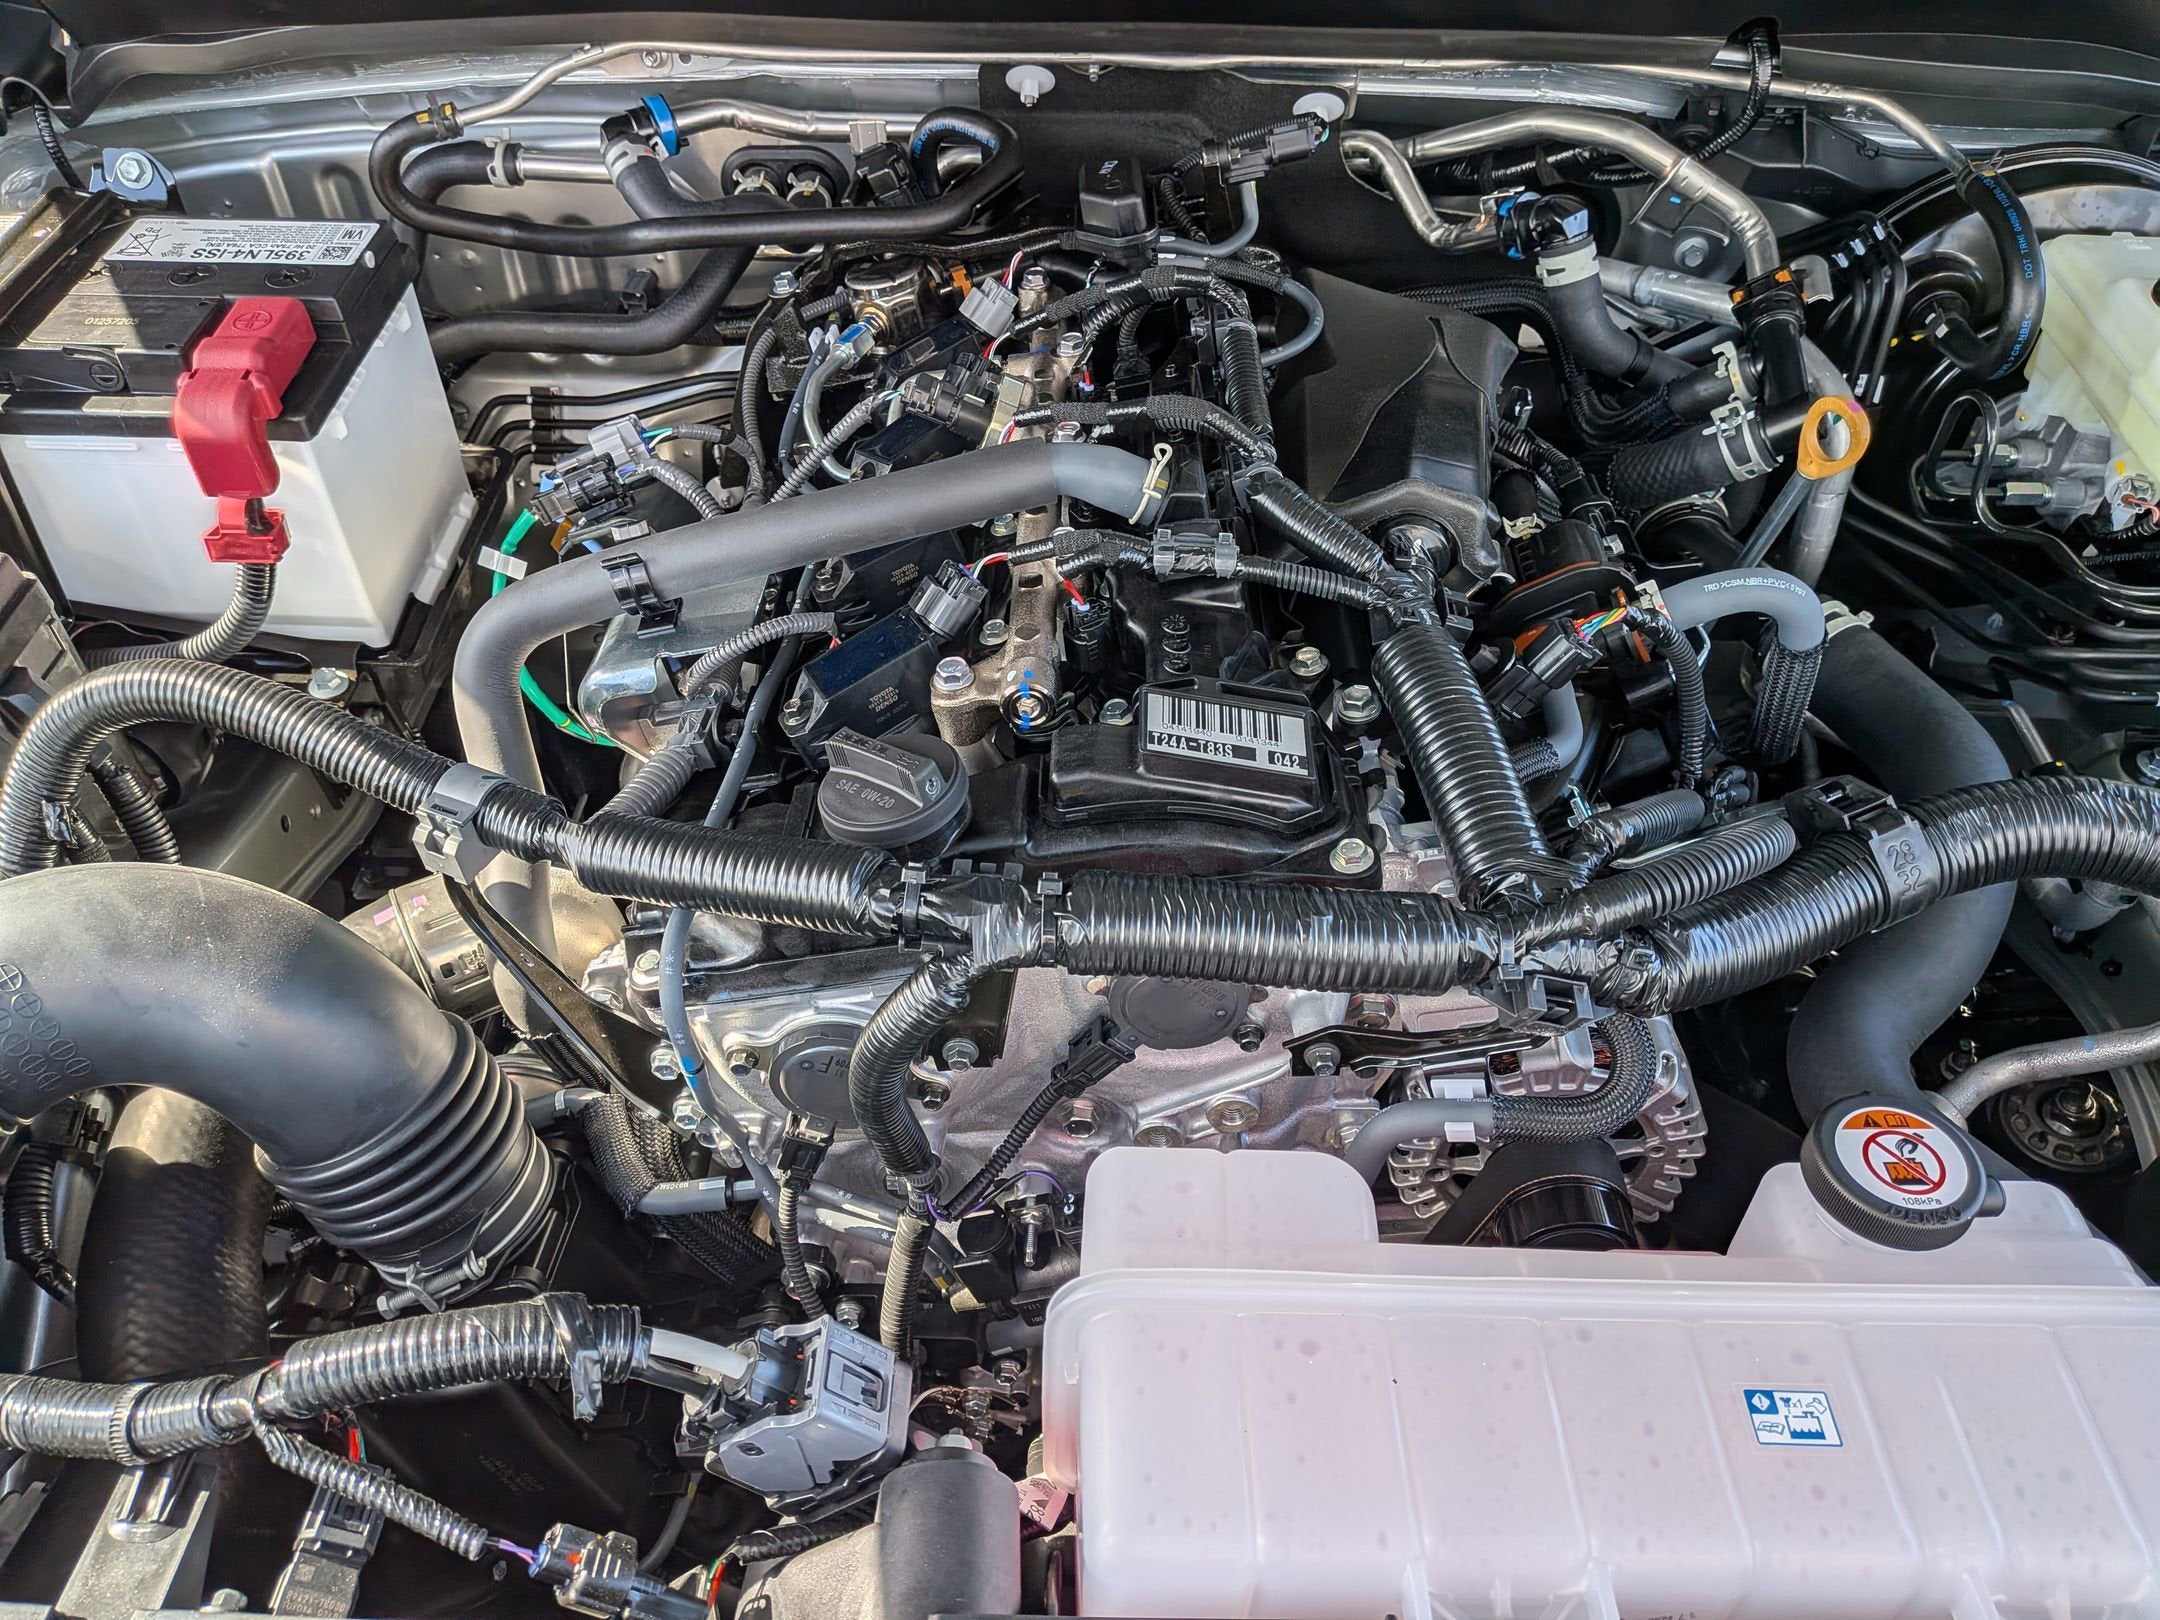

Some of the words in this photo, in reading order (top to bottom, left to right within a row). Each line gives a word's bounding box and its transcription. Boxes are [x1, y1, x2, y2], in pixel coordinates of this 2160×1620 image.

[341, 229, 363, 240] VM
[190, 248, 311, 261] 395LN4-ISS
[2023, 259, 2034, 279] DOT
[896, 571, 918, 586] DENSO
[869, 686, 895, 703] TOYOTA
[875, 694, 899, 712] DENSO
[1152, 732, 1233, 759] T24A-T83S
[1274, 752, 1300, 769] 042
[835, 779, 860, 794] SAE
[861, 788, 896, 809] 0W-20
[1887, 839, 1918, 871] 28
[1896, 864, 1930, 897] 32
[816, 1055, 835, 1074] F
[1902, 1197, 1943, 1207] 108kPa
[1886, 1205, 1962, 1226] DENSO
